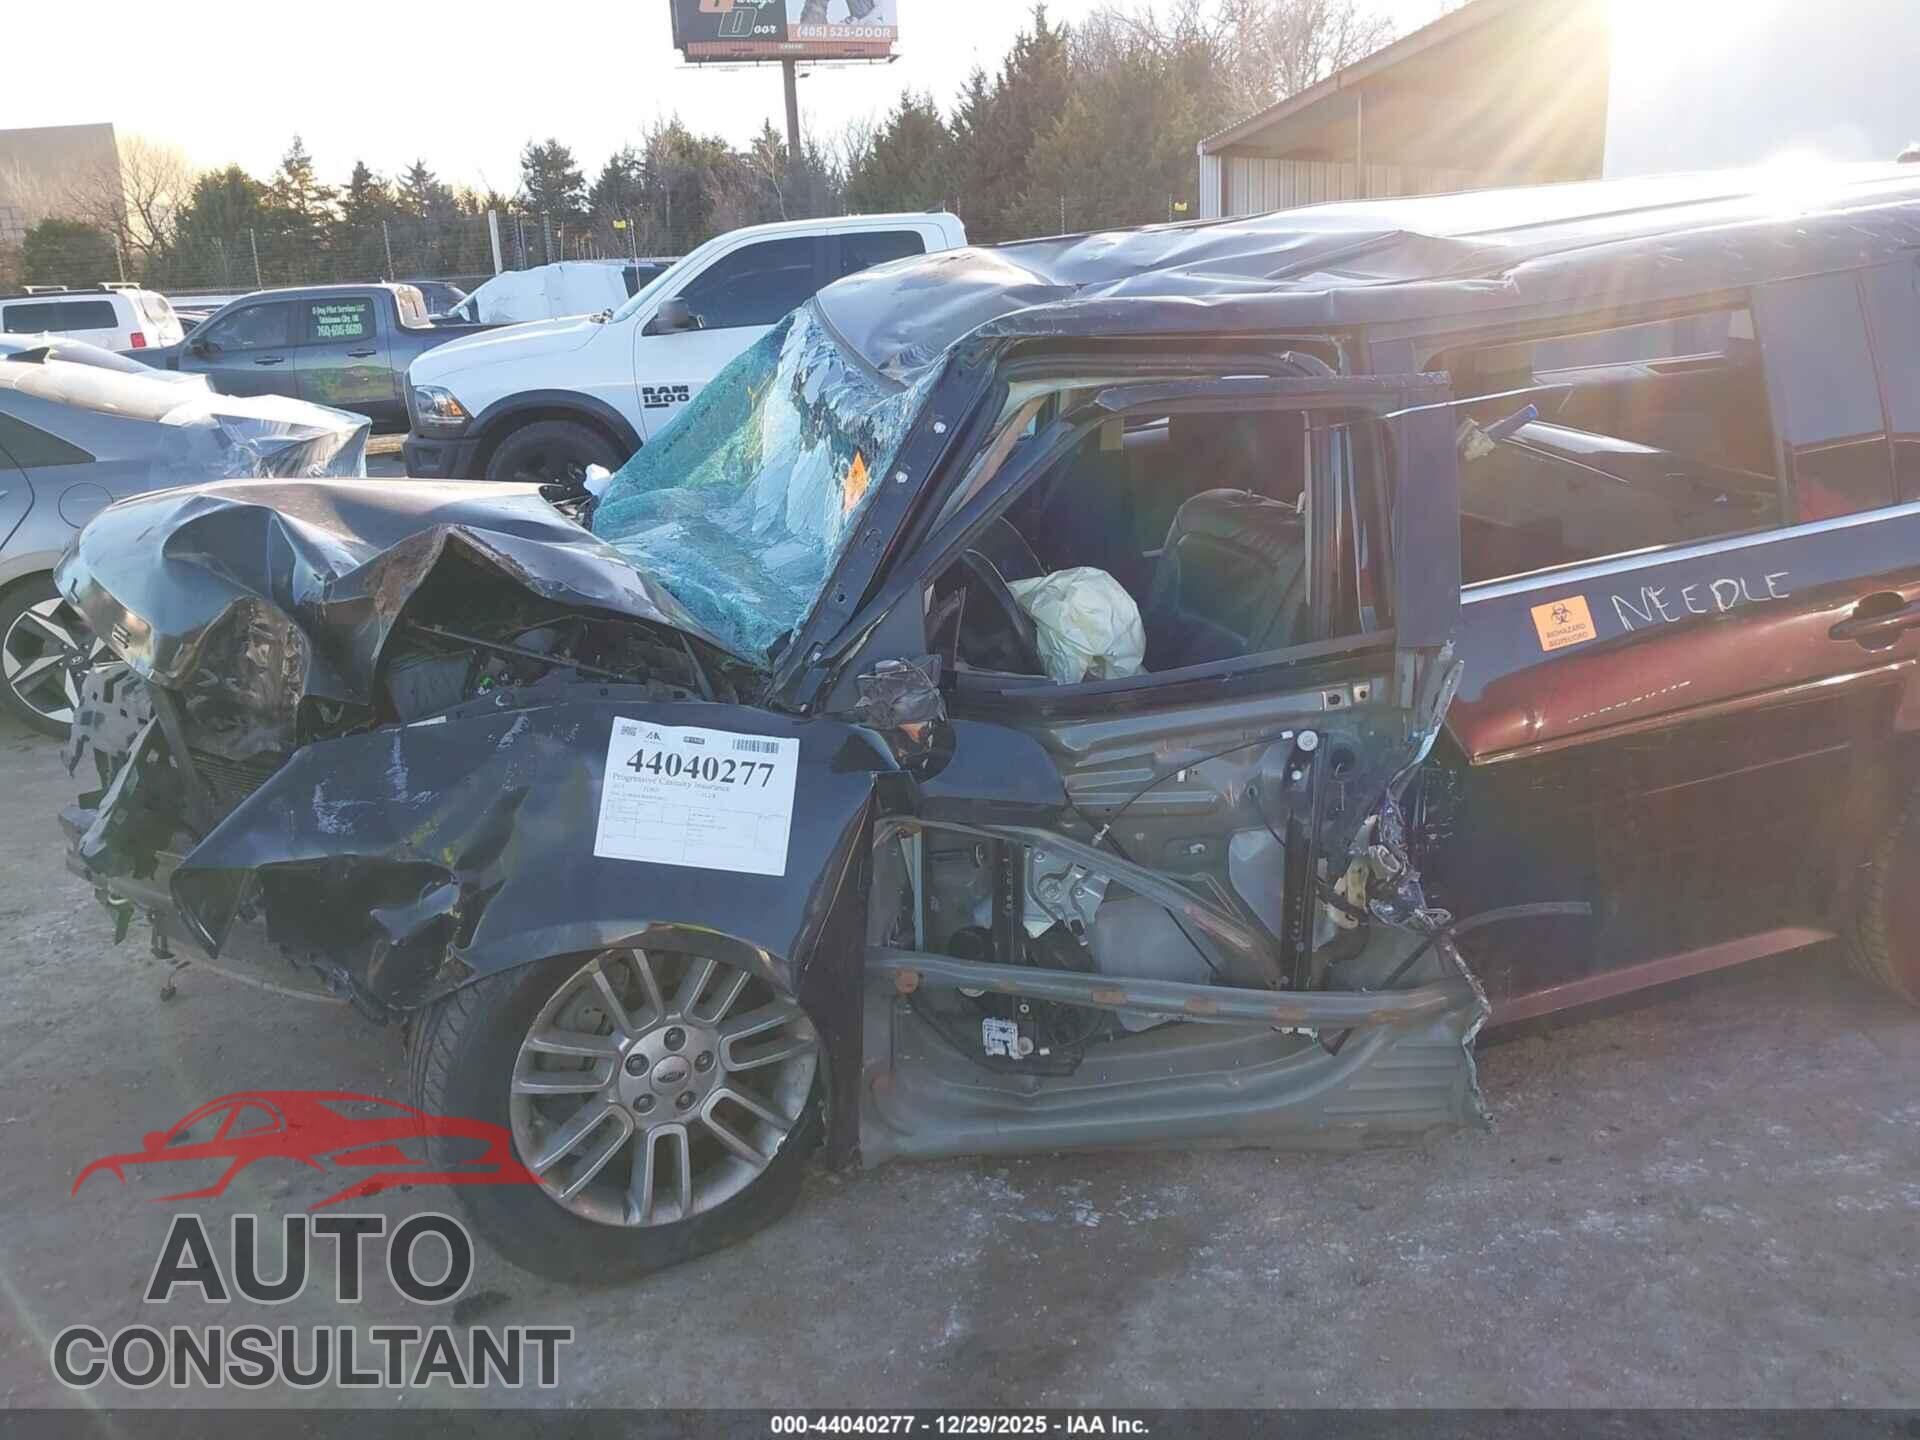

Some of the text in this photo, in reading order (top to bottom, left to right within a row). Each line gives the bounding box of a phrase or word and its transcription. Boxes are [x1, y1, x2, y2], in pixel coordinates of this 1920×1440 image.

[718, 7, 776, 37] Door
[830, 26, 891, 38] 525-DOOR
[642, 385, 689, 395] RAM
[644, 393, 690, 403] 1500
[1611, 571, 1791, 632] NEEDLE
[626, 748, 775, 788] 44040277
[612, 772, 659, 785] Progressive
